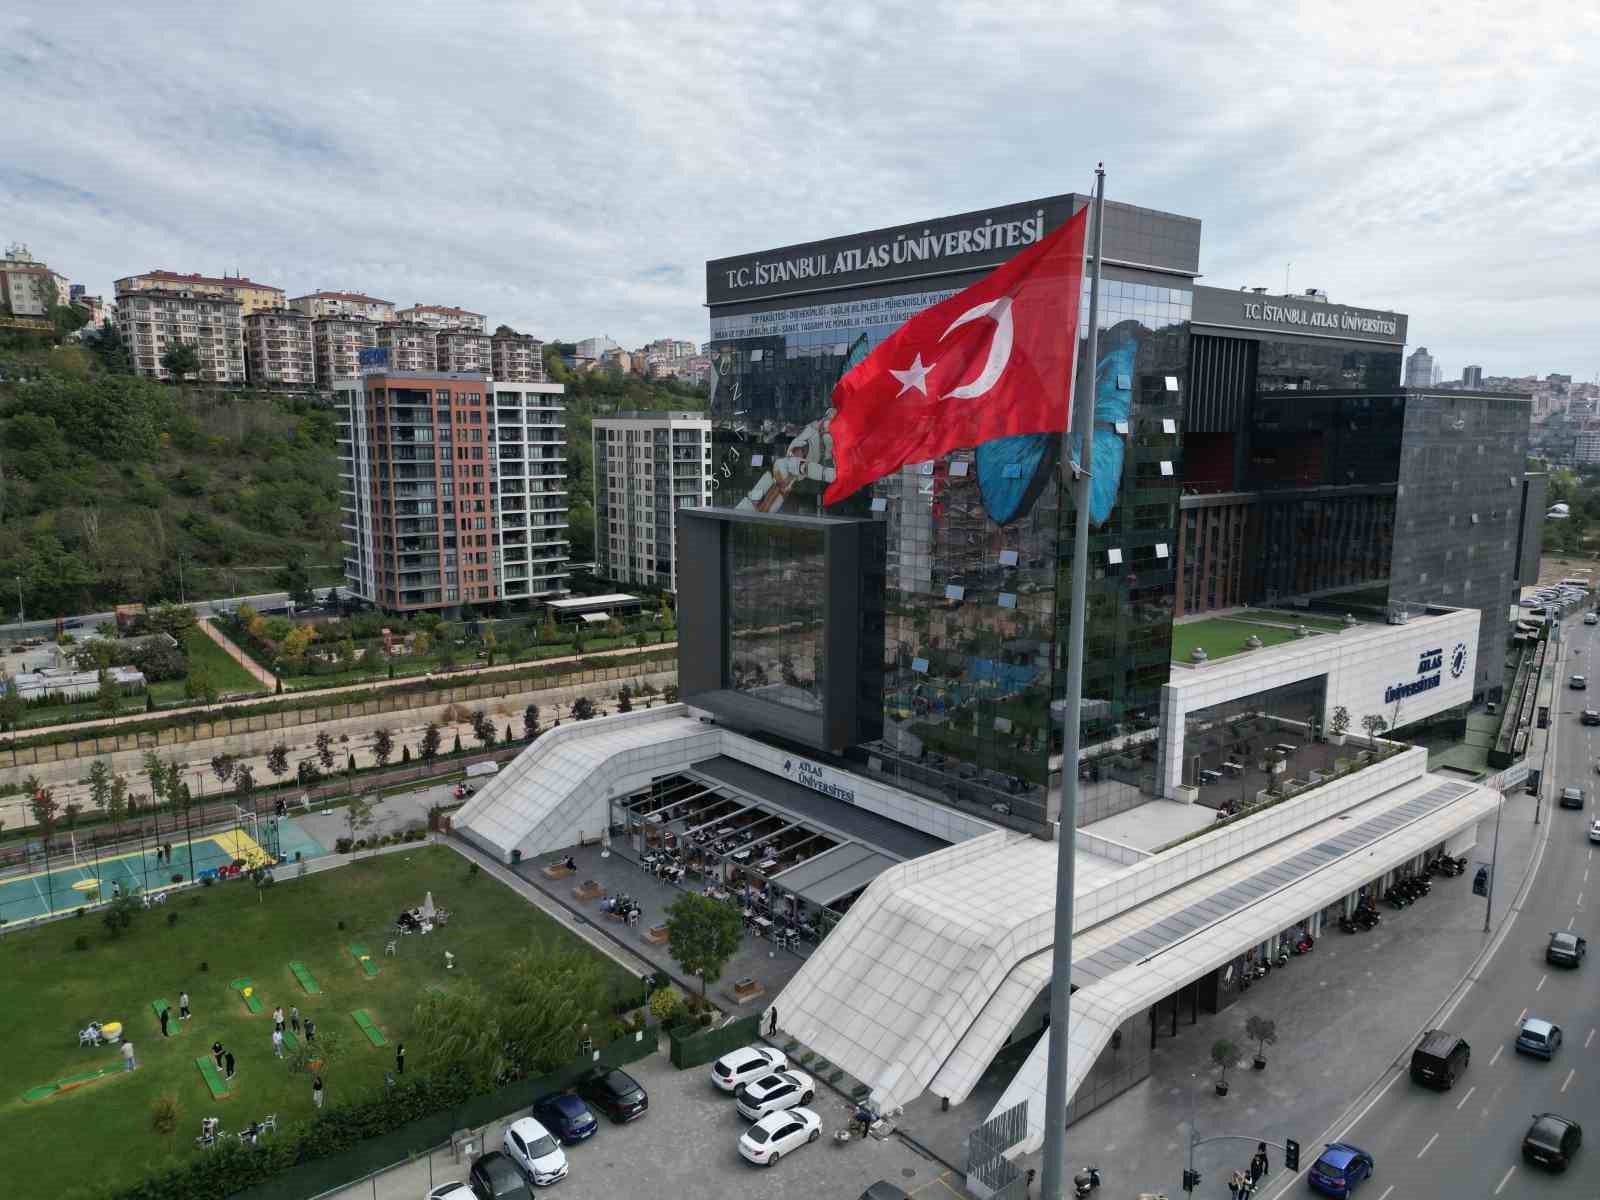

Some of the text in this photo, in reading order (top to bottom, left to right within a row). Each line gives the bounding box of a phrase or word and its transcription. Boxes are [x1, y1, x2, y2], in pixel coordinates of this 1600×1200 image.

[754, 260, 831, 285] İSTANBUL
[832, 244, 890, 274] ATLAS
[892, 209, 1044, 263] ÜNİVERSİTESİ
[1263, 302, 1308, 325] İSTANBUL
[1310, 314, 1338, 329] ATLAS
[1341, 311, 1396, 336] ÜNİVERSİTESİ
[1417, 655, 1442, 674] ATLAS
[799, 762, 823, 778] ATLAS
[799, 773, 855, 803] ÜNİVERSİTESİ
